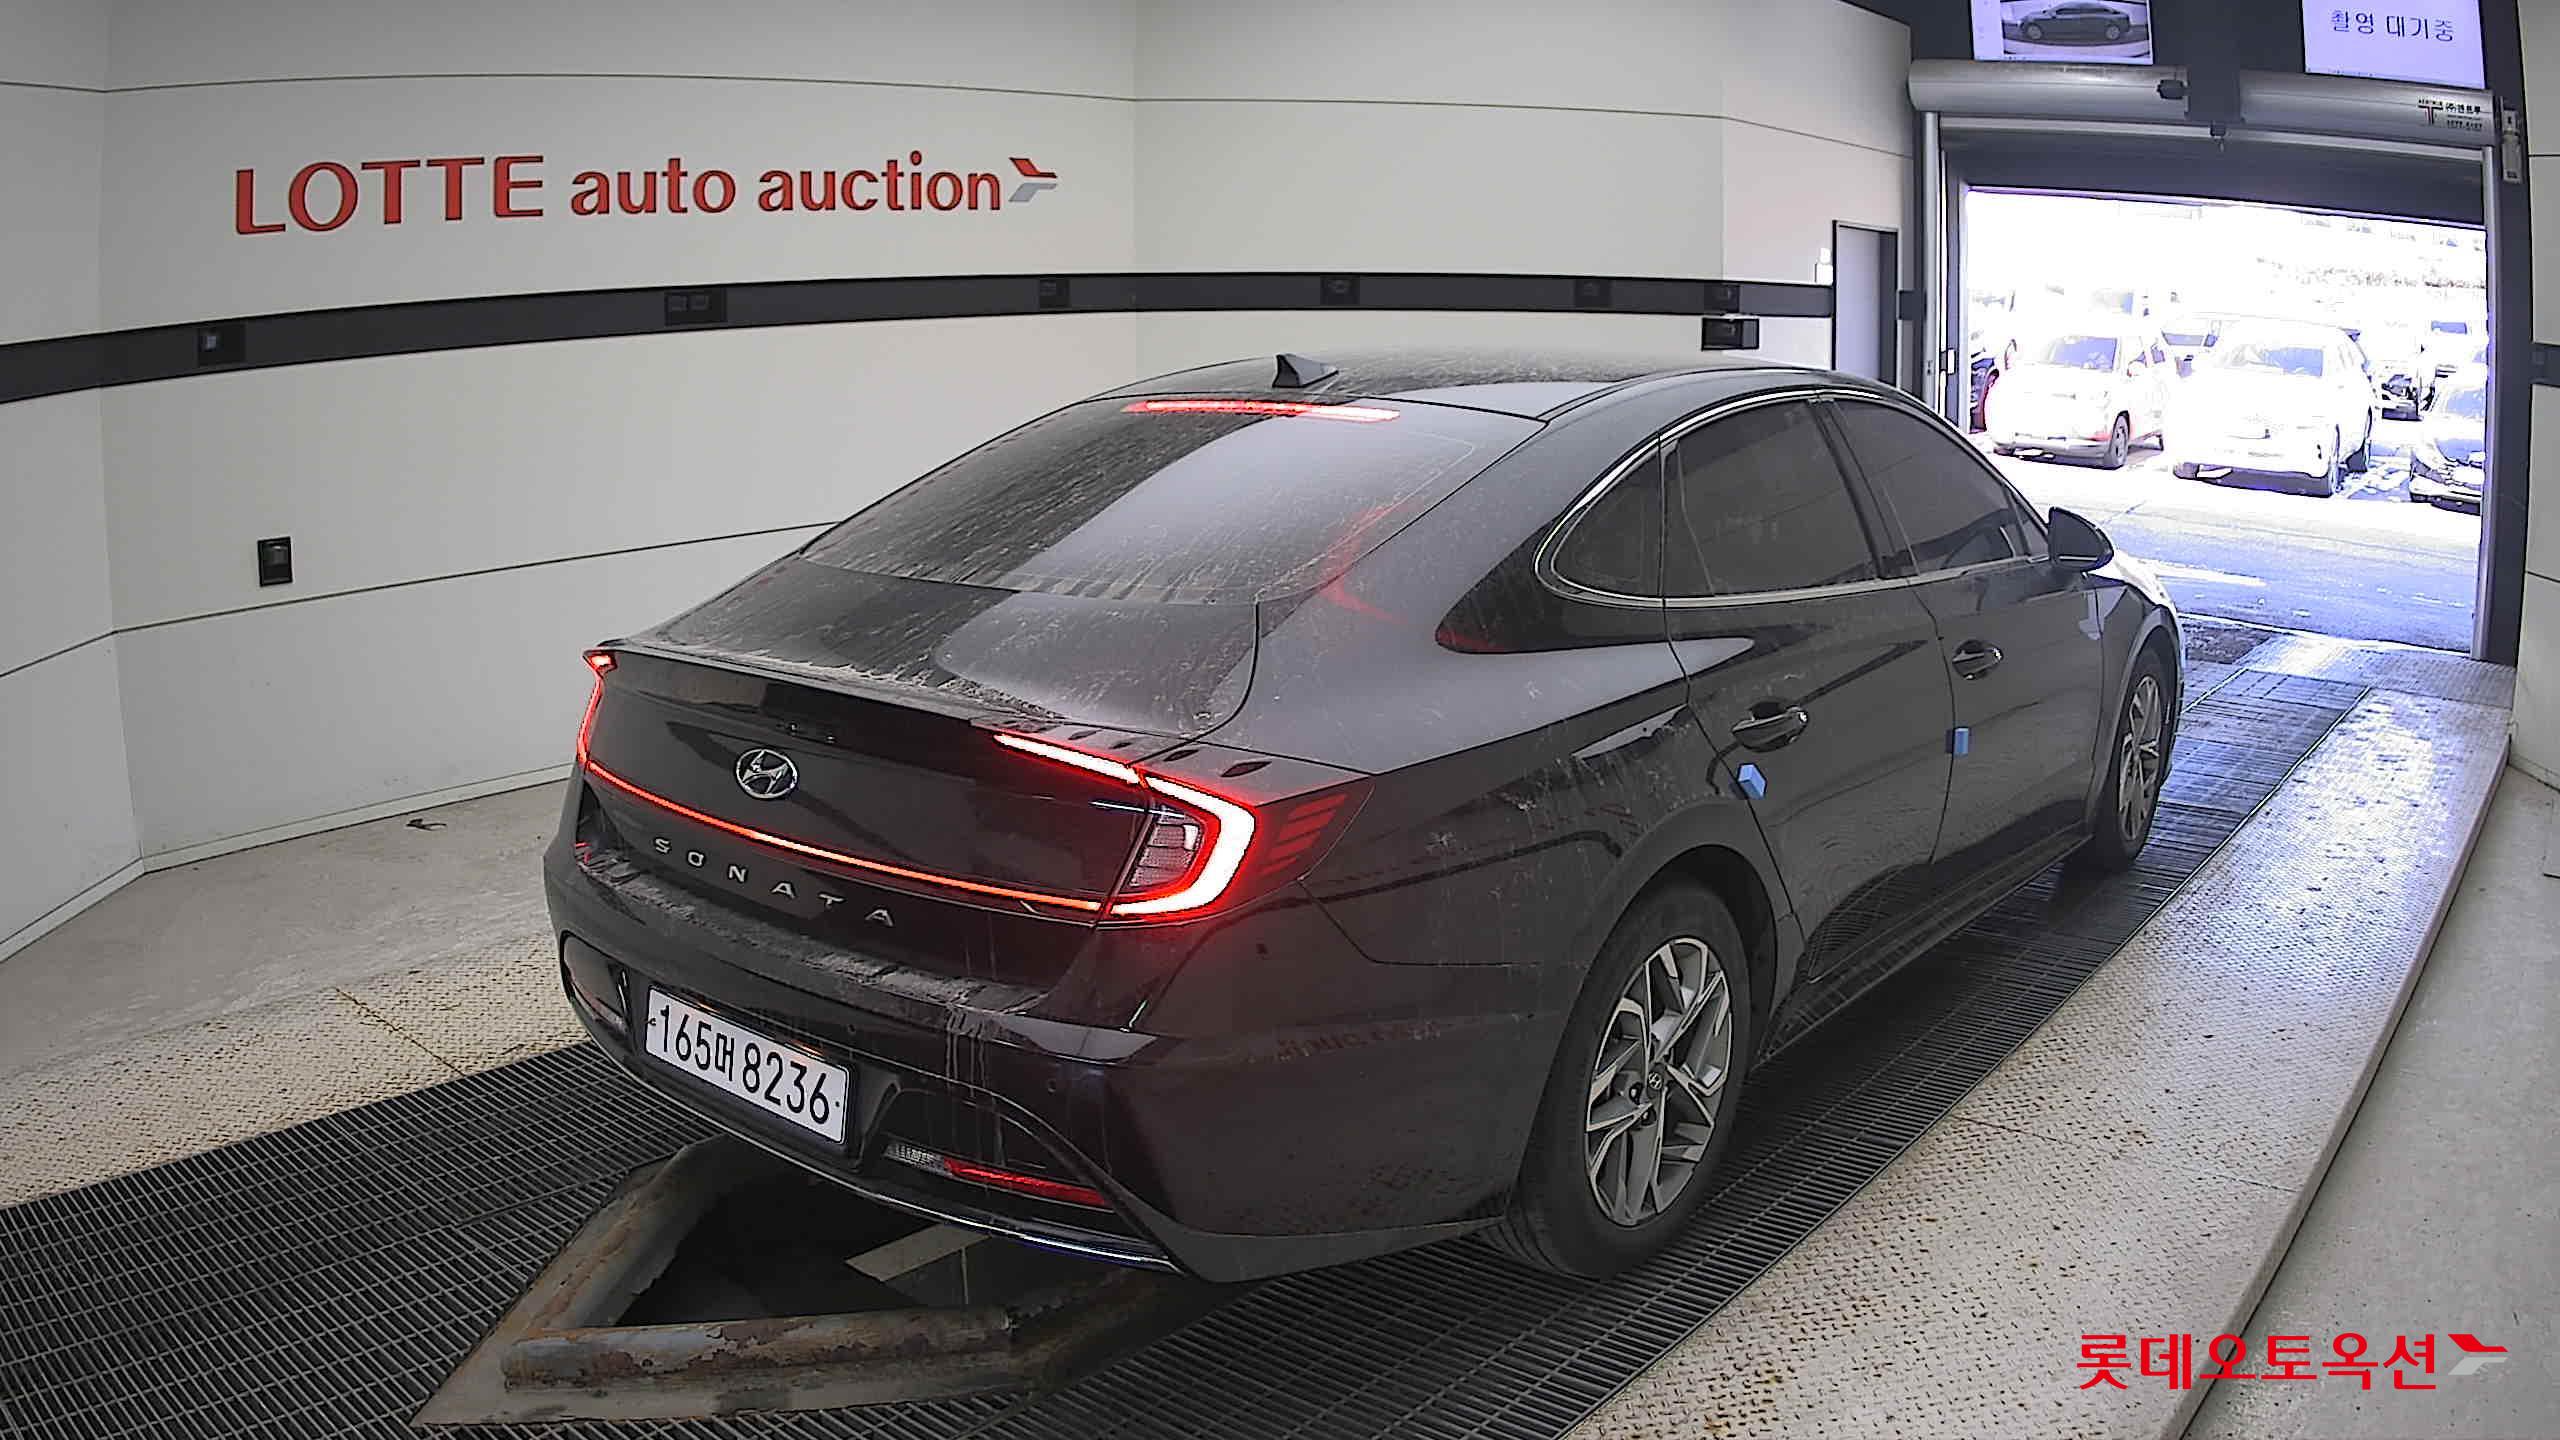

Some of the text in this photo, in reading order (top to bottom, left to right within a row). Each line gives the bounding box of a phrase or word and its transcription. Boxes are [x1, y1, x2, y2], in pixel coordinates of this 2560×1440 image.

[2331, 9, 2454, 42] 촬영 대기중
[236, 150, 1003, 234] LOTTE auto auction
[654, 837, 894, 927] SONATA
[742, 1042, 830, 1125] 8236
